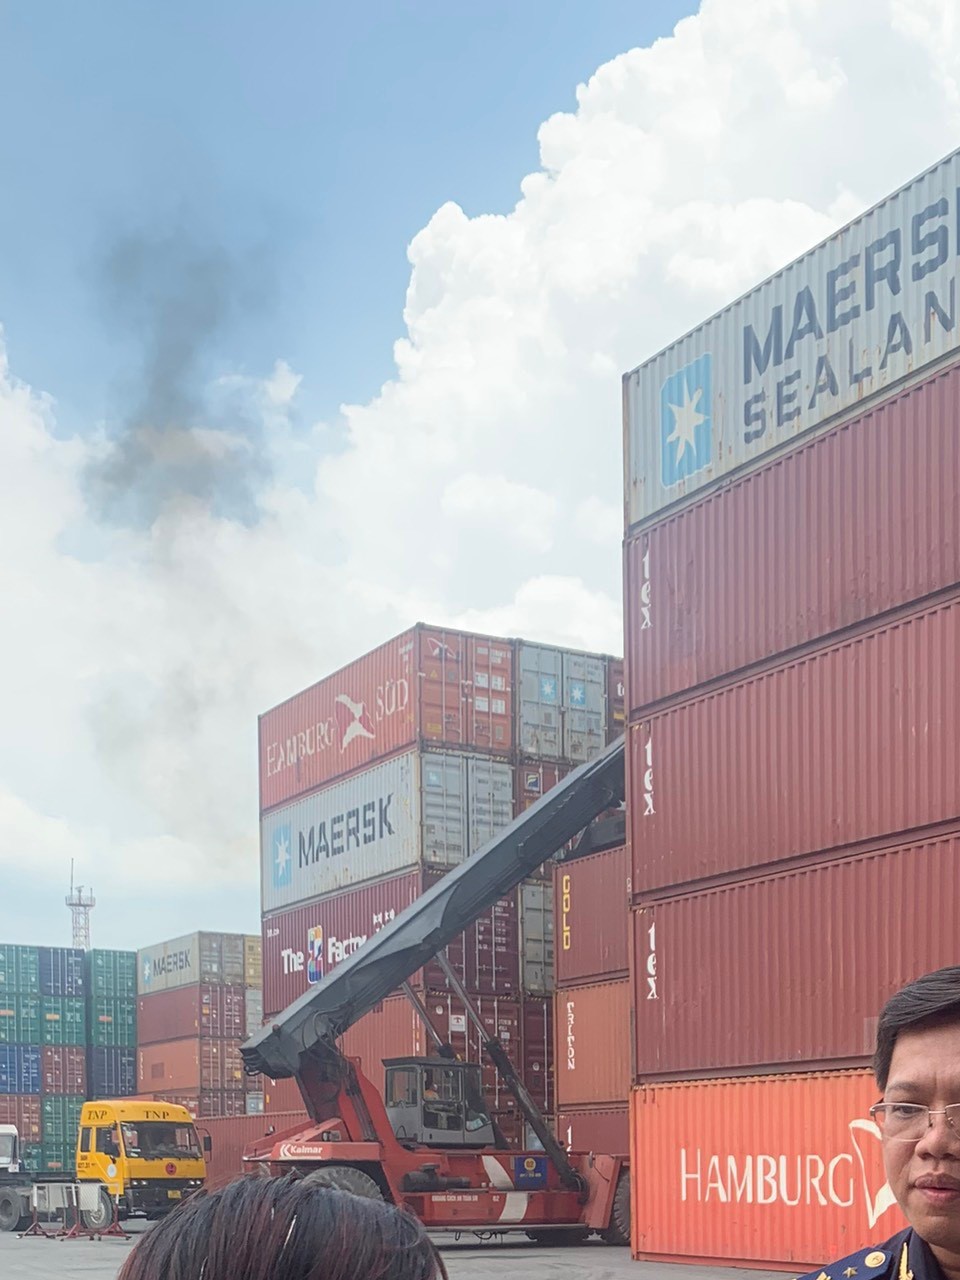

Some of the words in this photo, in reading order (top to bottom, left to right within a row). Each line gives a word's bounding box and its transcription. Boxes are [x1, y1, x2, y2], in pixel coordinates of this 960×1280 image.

[641, 549, 653, 628] tex
[267, 717, 335, 778] HAMBURG
[375, 678, 409, 723] SÜD
[643, 737, 656, 815] tex
[298, 792, 395, 868] MAERSK
[153, 950, 191, 977] MAERSK
[281, 947, 304, 975] The
[646, 922, 659, 999] tex
[567, 1001, 575, 1070] TRITON
[87, 1110, 108, 1120] TNP
[143, 1110, 170, 1120] TNP
[290, 1145, 323, 1155] Kalmar
[680, 1147, 854, 1207] HAMBURG
